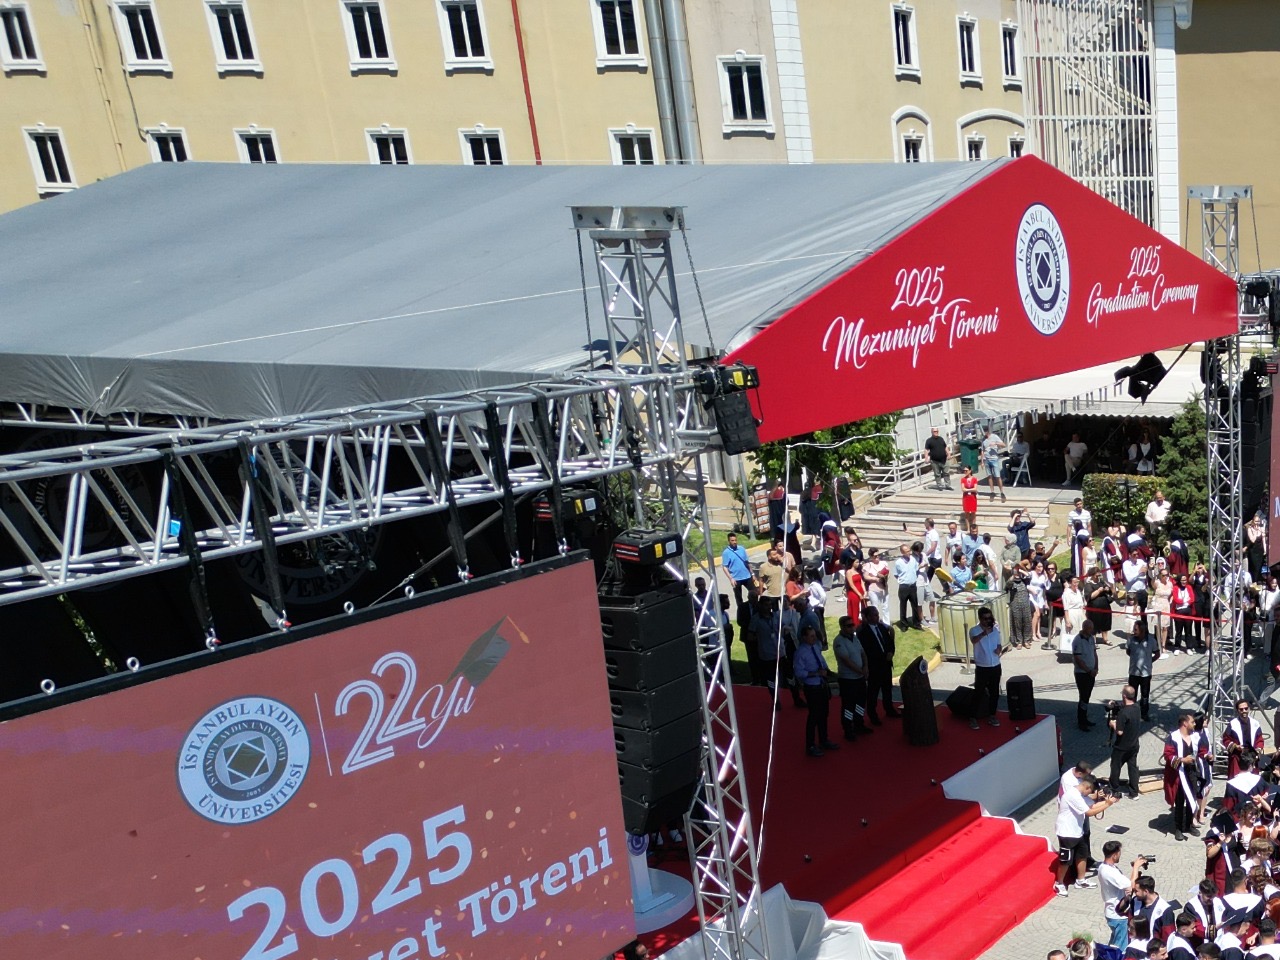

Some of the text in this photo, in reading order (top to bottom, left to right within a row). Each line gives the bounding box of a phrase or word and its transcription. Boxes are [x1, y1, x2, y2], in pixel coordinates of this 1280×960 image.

[890, 265, 945, 311] 2025
[1127, 244, 1161, 279] 2025
[1086, 273, 1199, 328] Graduation Ceremony
[822, 298, 1000, 370] Mezuniyet Töreni
[181, 703, 301, 770] İSTANBUL AYDIN
[335, 652, 475, 774] 22 Yıl
[198, 763, 304, 820] ÜNİVERSİTESİ
[459, 827, 613, 937] Töreni
